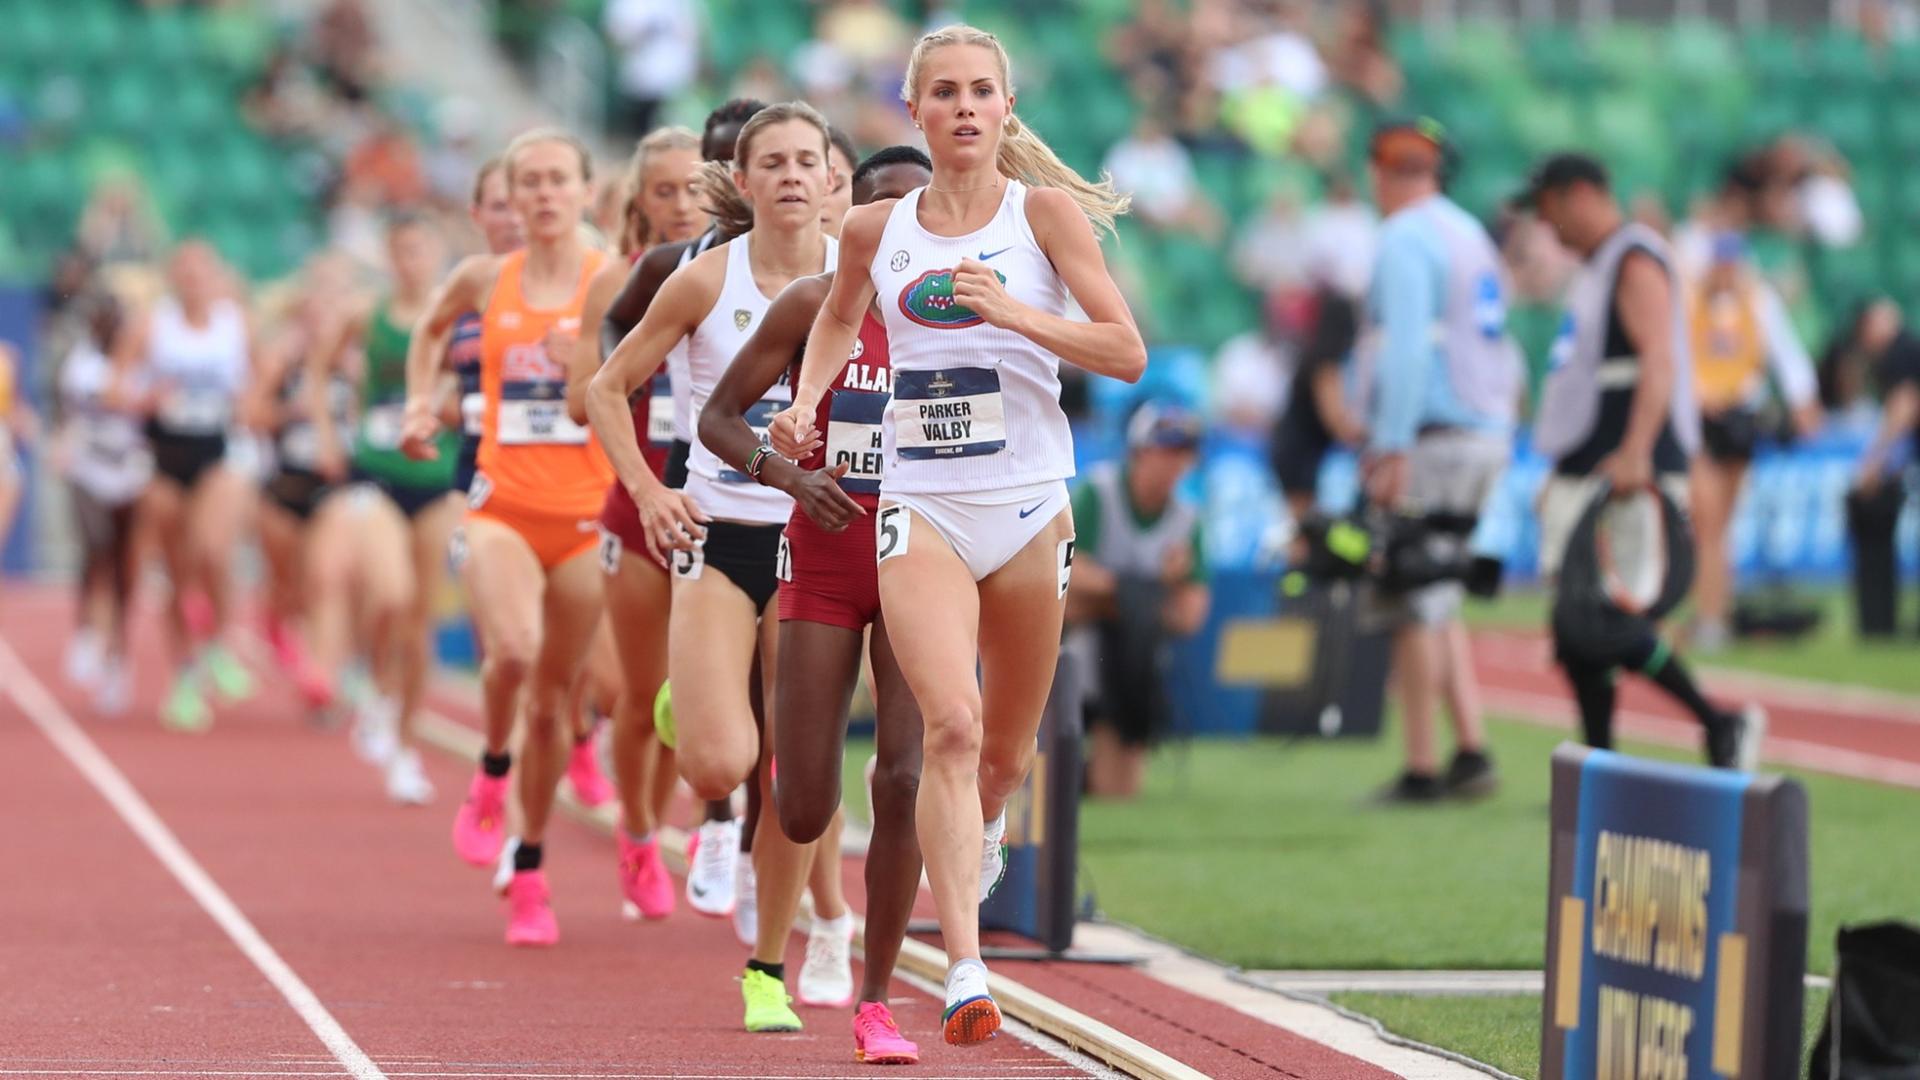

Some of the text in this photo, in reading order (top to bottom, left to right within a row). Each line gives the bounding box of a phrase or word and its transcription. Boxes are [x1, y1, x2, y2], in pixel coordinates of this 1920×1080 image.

[919, 402, 972, 419] PARKER
[922, 420, 972, 441] VALBY
[880, 507, 900, 561] 5
